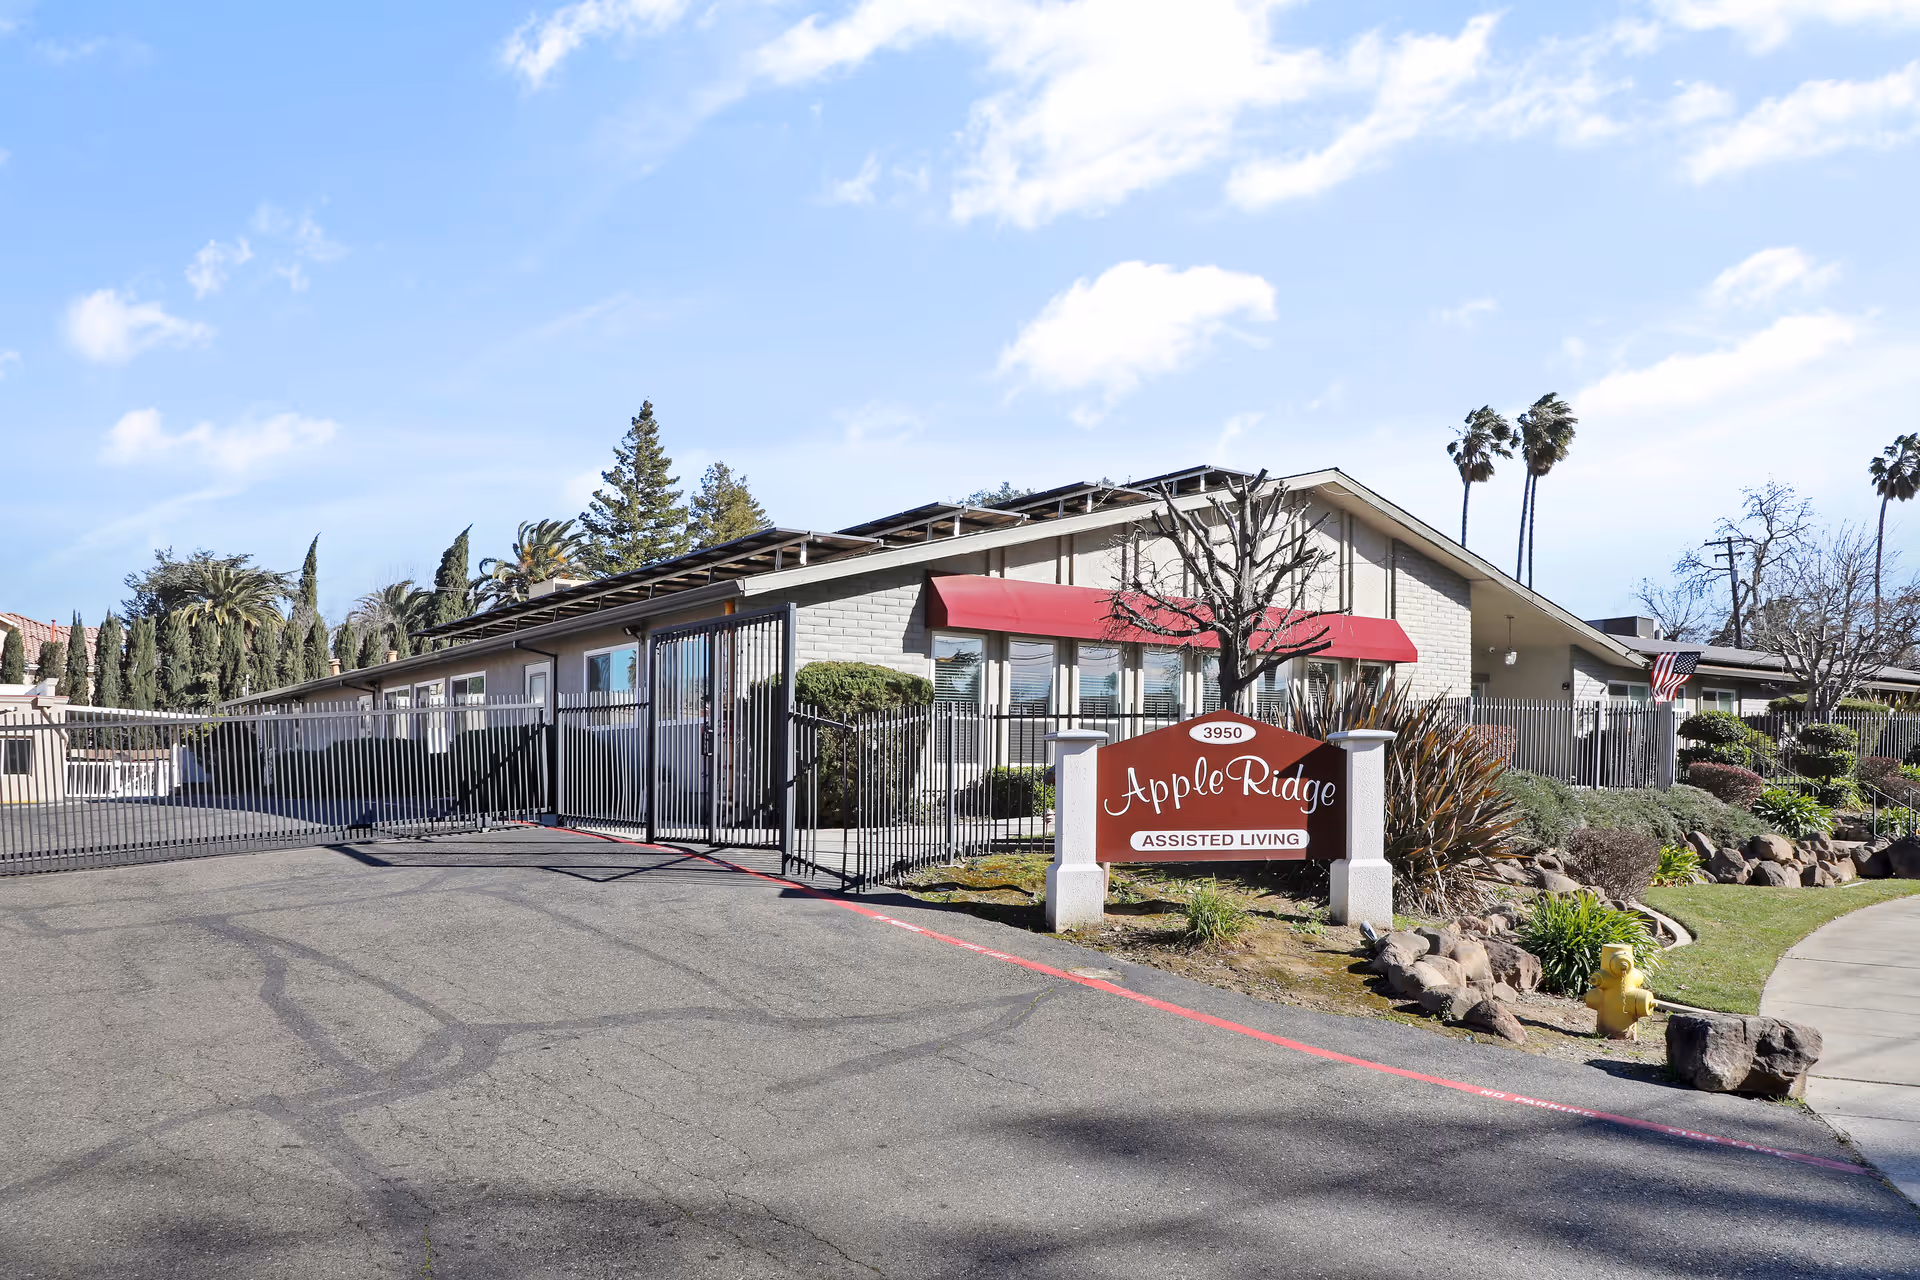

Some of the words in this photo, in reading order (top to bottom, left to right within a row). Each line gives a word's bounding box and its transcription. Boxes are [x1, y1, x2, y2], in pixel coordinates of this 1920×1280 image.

[1203, 726, 1243, 739] 3950
[1104, 756, 1224, 816] Apple
[1225, 755, 1336, 815] Ridge
[1142, 833, 1234, 847] ASSISTED
[1240, 832, 1300, 846] LIVING
[1480, 1089, 1506, 1099] NO
[1514, 1096, 1597, 1118] PARKING
